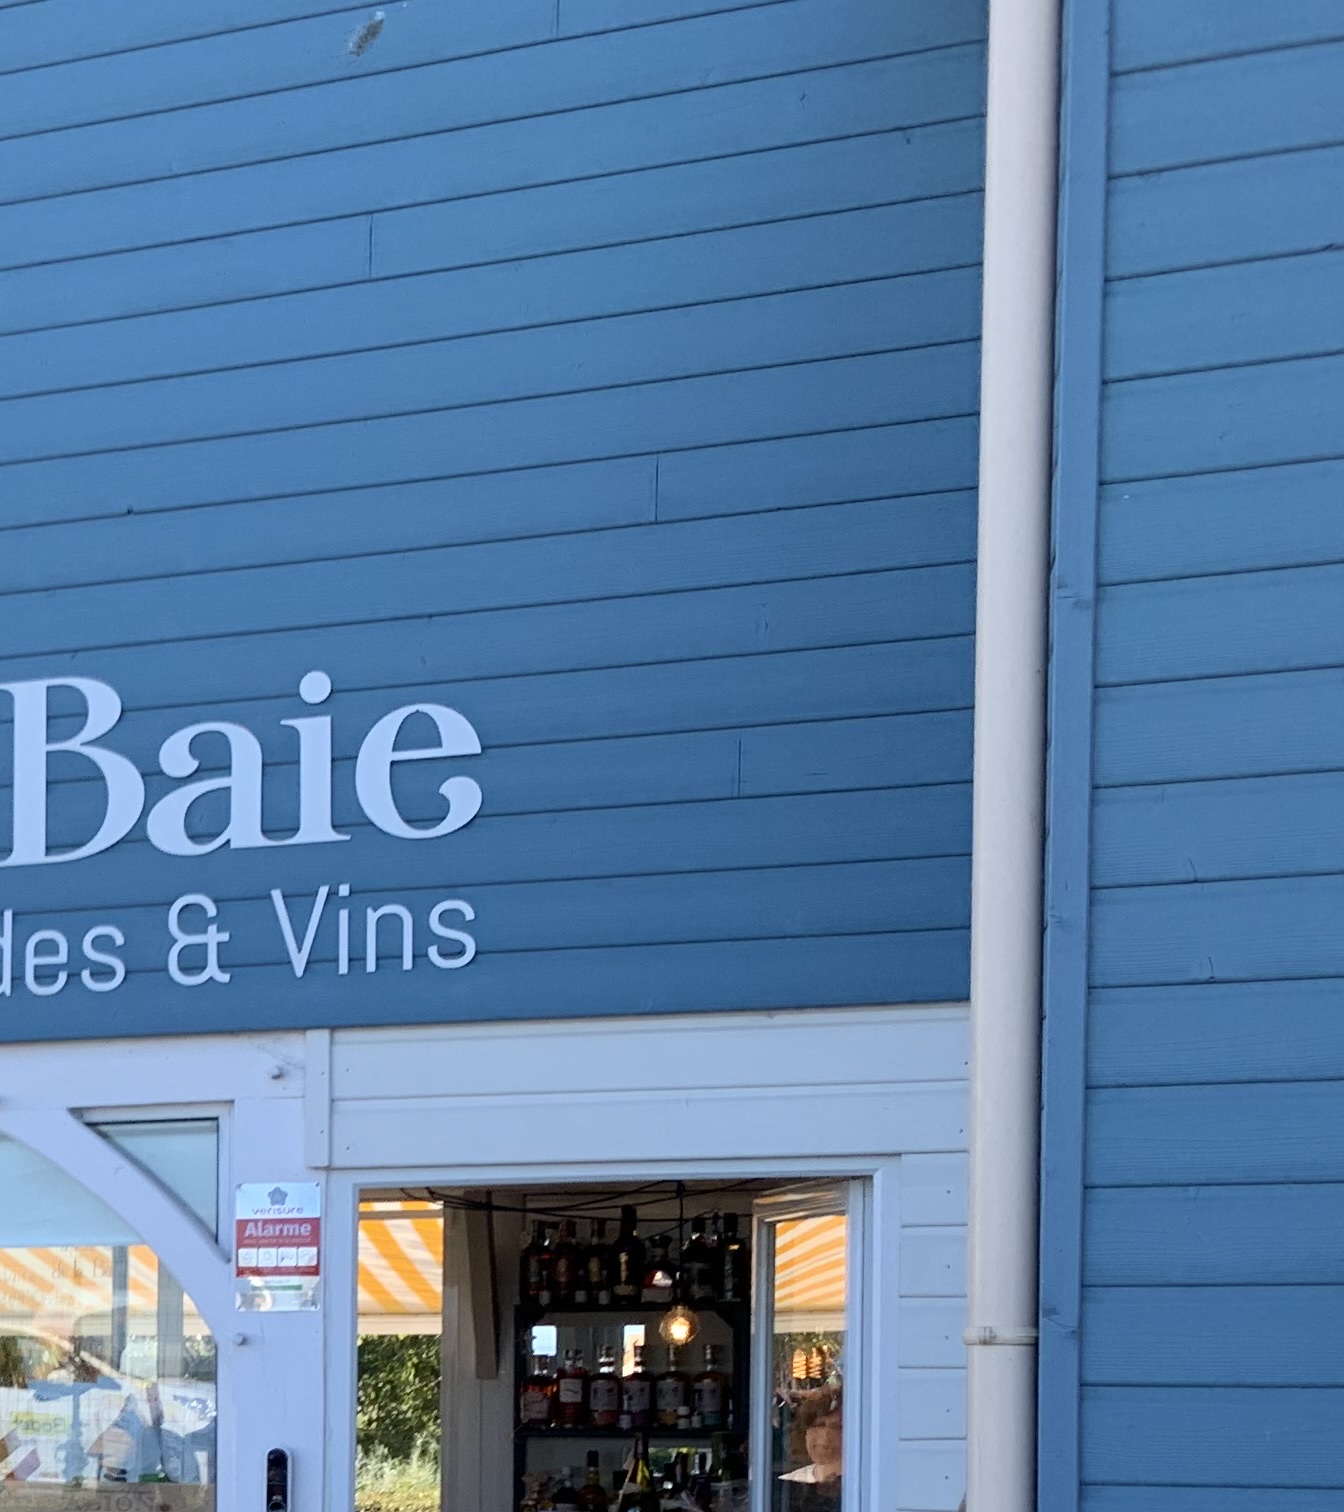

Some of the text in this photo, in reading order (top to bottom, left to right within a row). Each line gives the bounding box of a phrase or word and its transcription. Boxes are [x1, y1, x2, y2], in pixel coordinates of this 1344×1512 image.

[169, 895, 230, 984] &
[271, 883, 475, 977] Vins
[244, 1221, 311, 1237] Alarme
